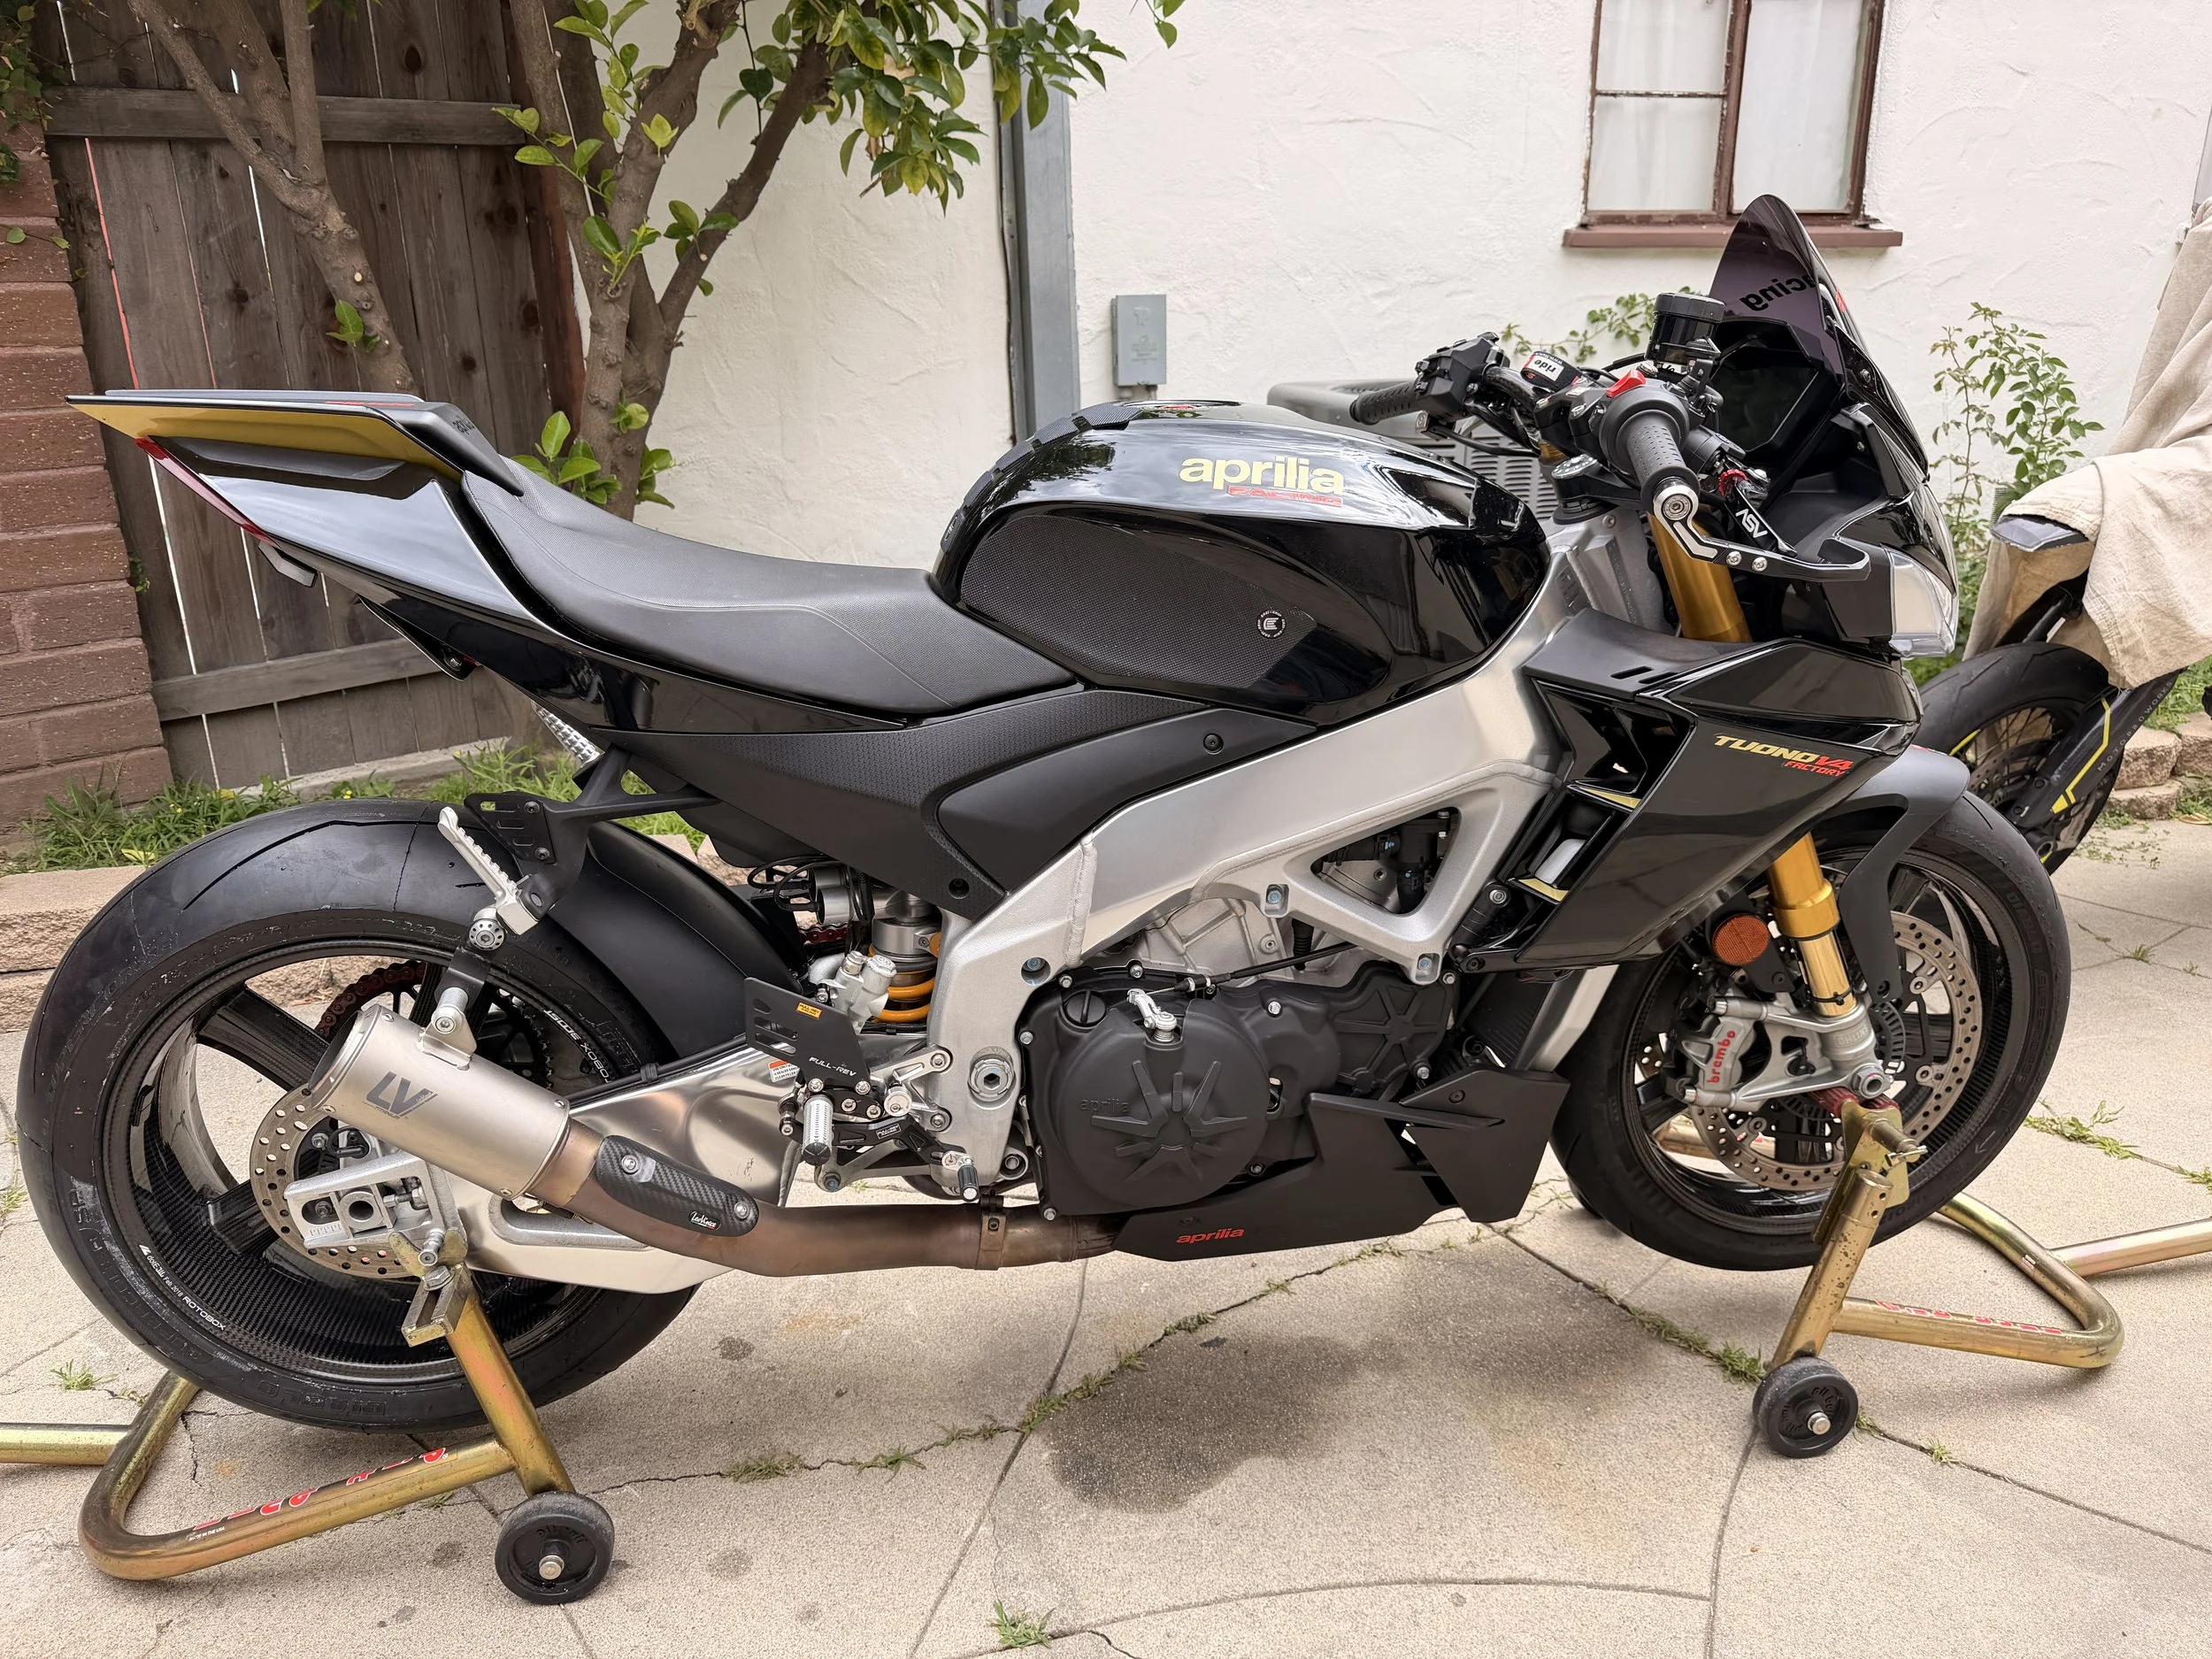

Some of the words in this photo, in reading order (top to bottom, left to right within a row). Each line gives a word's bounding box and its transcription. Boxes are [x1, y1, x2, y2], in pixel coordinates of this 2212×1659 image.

[1534, 359, 1557, 373] ride
[1179, 456, 1344, 494] aprilia
[1784, 761, 1846, 777] FACTORY
[581, 1042, 611, 1084] TOBOX
[809, 1056, 856, 1077] FULL-REV
[1706, 1031, 1736, 1085] brembo
[366, 1071, 434, 1115] LV
[1080, 1098, 1130, 1115] aprilia
[1176, 1228, 1245, 1244] aprilia
[182, 1296, 226, 1330] ROTOBOX
